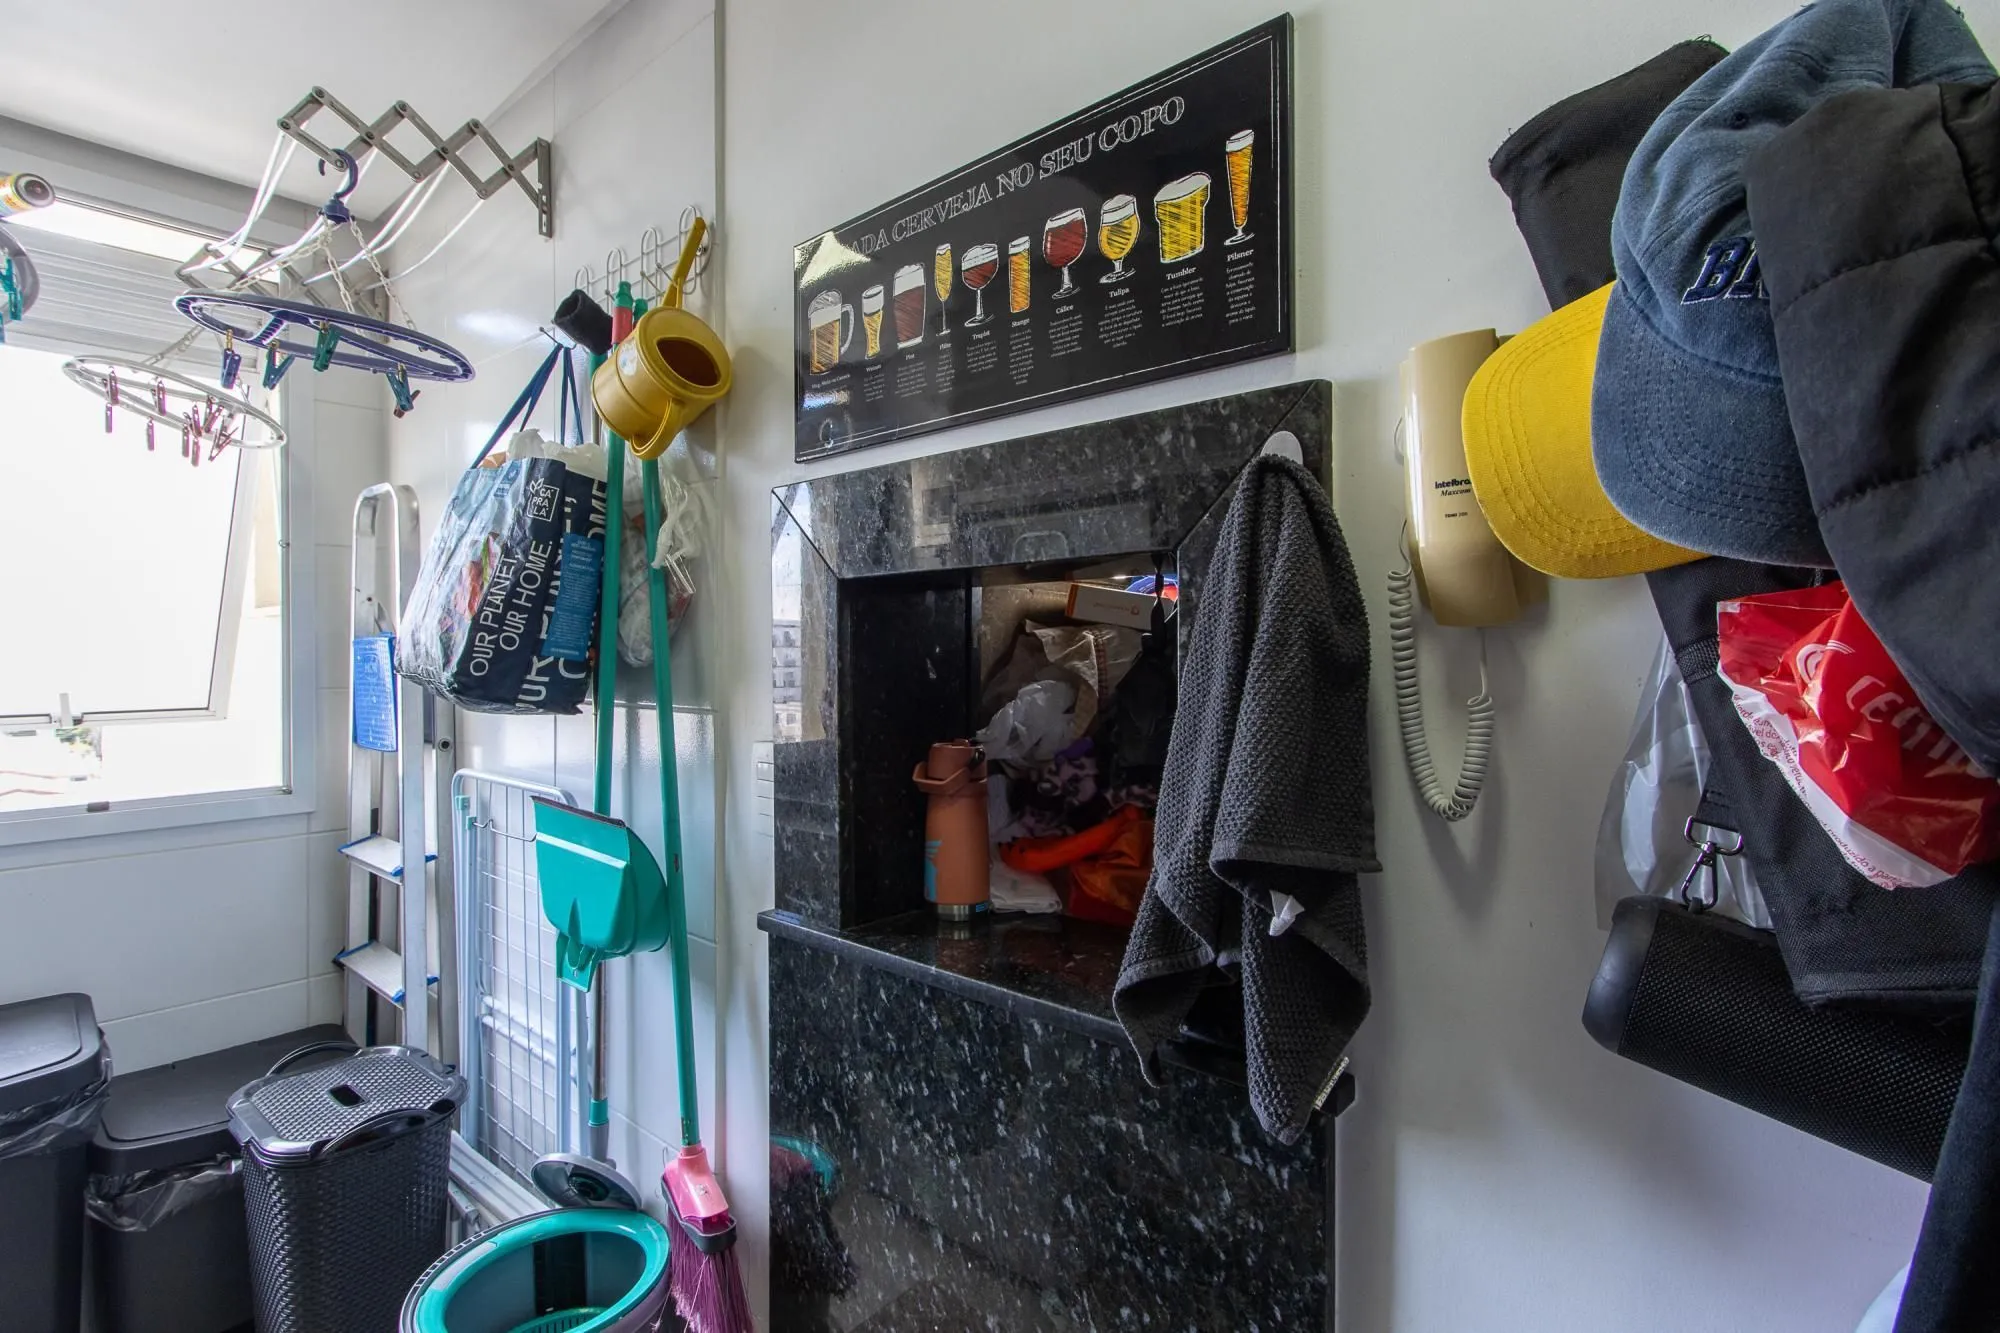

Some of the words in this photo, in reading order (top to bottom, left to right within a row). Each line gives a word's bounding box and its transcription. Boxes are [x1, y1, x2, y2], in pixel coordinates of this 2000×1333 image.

[852, 228, 891, 254] ADA
[892, 182, 993, 242] CERVEJA
[996, 161, 1035, 199] NO
[1039, 133, 1096, 180] SEU
[1098, 96, 1185, 151] COPO
[1227, 249, 1254, 262] Pilsner
[1166, 266, 1197, 280] Tumbler
[1109, 287, 1130, 298] Tulipa
[1435, 479, 1472, 488] Intelbra
[1441, 488, 1471, 496] Maxcom
[531, 497, 549, 507] PRA
[512, 540, 553, 607] HOME.
[479, 553, 521, 628] PLANET,
[499, 610, 529, 651] OUR
[470, 631, 498, 676] OUR
[1828, 828, 1869, 867] produzido
[1868, 865, 1877, 873] a
